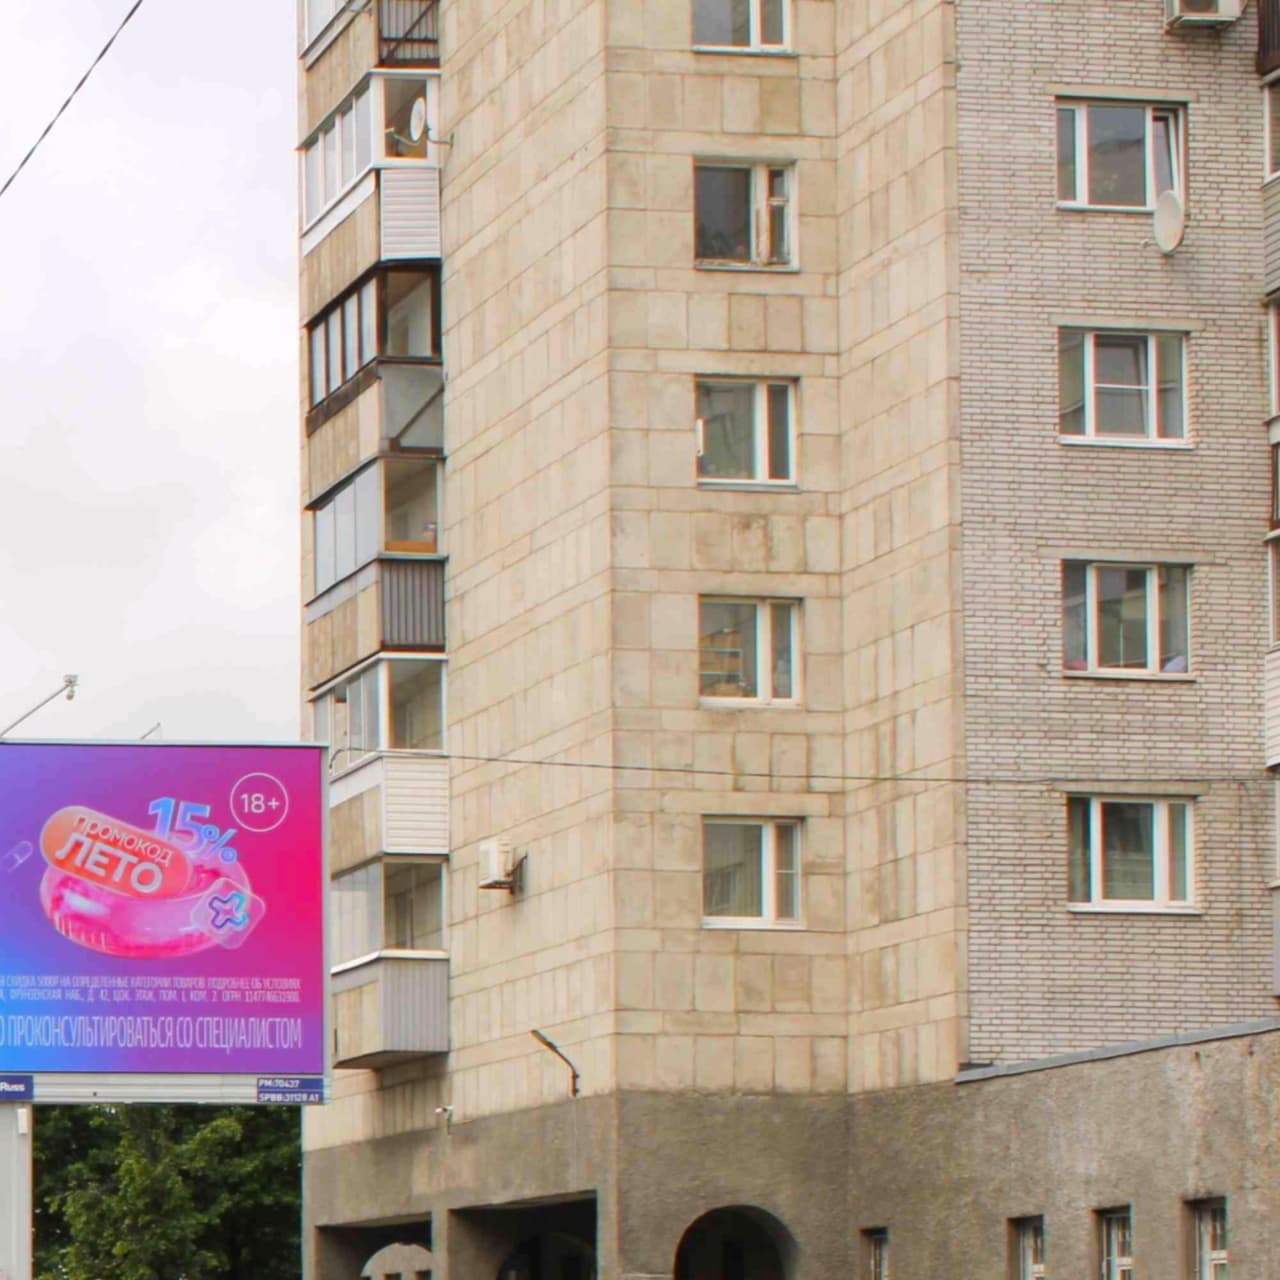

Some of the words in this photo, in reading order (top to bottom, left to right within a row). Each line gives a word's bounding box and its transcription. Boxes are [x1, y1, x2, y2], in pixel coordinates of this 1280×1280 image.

[240, 793, 280, 814] 18+
[147, 796, 238, 863] 15%
[55, 832, 163, 894] ЛЕТО
[8, 1015, 174, 1048] ПРОКОНСУЛЬТИРОВАТЬСЯ
[176, 1017, 193, 1048] СО
[196, 1017, 302, 1054] СПЕЦИАЛИСТОМ
